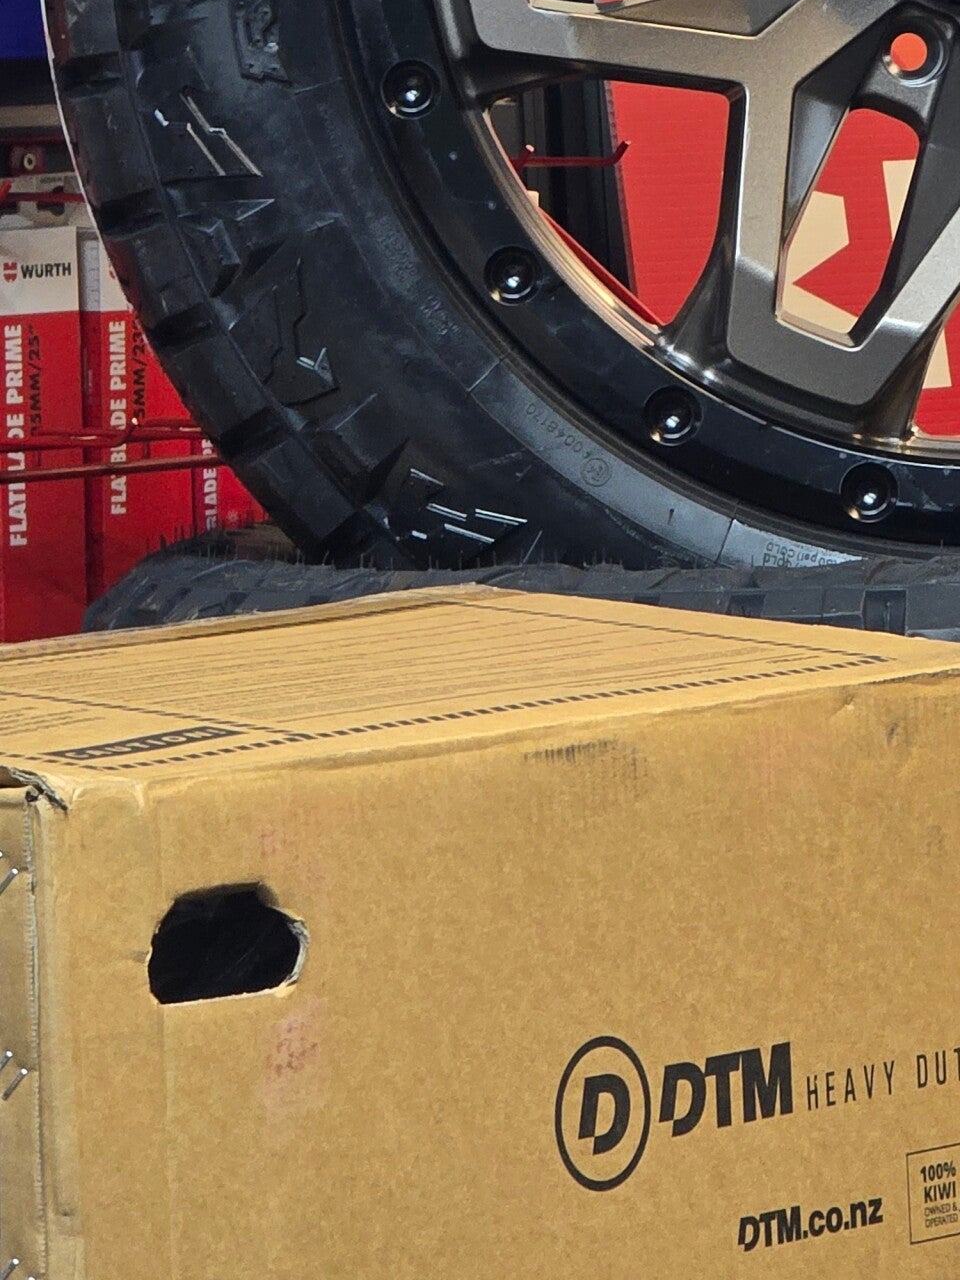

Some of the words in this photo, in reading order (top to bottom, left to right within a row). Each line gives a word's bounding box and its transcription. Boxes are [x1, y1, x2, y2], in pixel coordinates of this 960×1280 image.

[21, 261, 72, 280] WURTH
[4, 324, 24, 405] PRIME
[108, 321, 126, 391] PRIME
[64, 727, 228, 760] CAUTION!
[658, 1041, 794, 1138] DTM
[806, 1060, 896, 1112] HEAVY
[920, 1160, 958, 1183] 100%
[924, 1180, 957, 1204] KIWI
[924, 1202, 951, 1218] OWNED
[924, 1213, 959, 1229] OPERATED
[736, 1197, 884, 1252] DTM.co.nz
